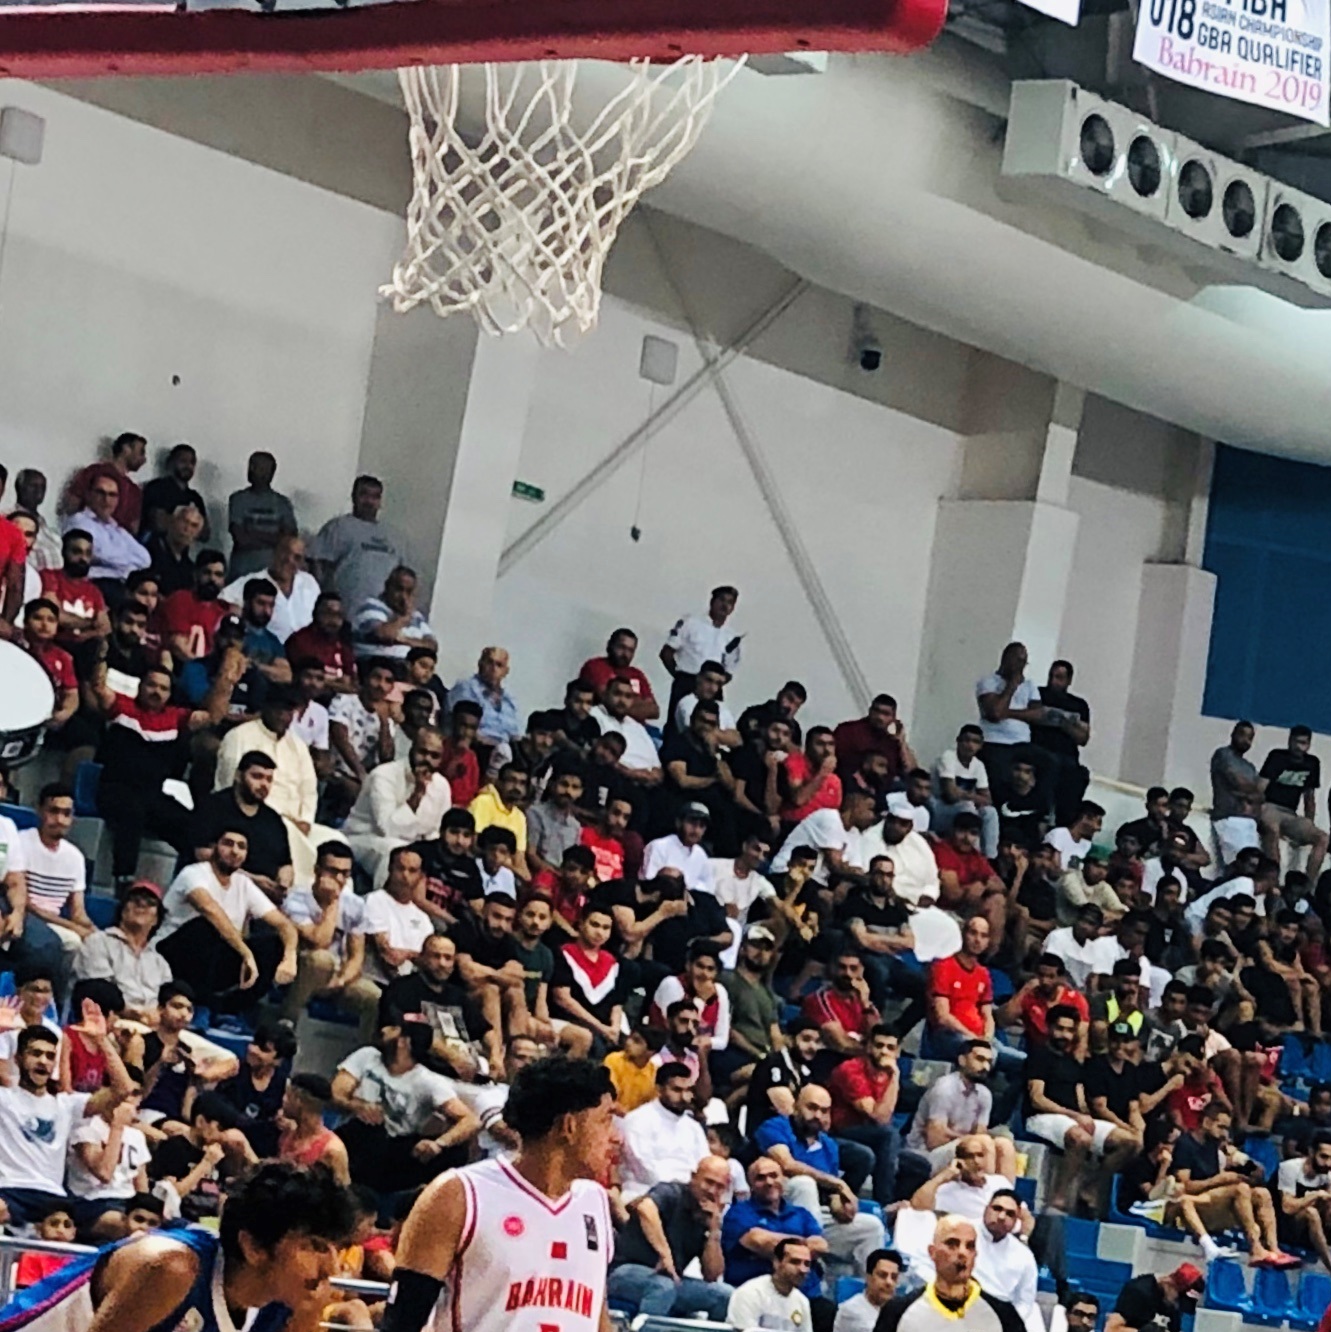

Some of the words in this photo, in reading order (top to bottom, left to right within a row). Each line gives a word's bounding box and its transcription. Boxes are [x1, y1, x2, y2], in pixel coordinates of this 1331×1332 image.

[1149, 0, 1196, 40] U18
[1225, 0, 1287, 23] BA
[1157, 36, 1256, 93] Bahrain
[1264, 71, 1322, 111] 2019
[1197, 22, 1231, 54] GBA
[1237, 36, 1322, 82] QUALIFIER
[505, 1276, 594, 1319] BAHRAIN
